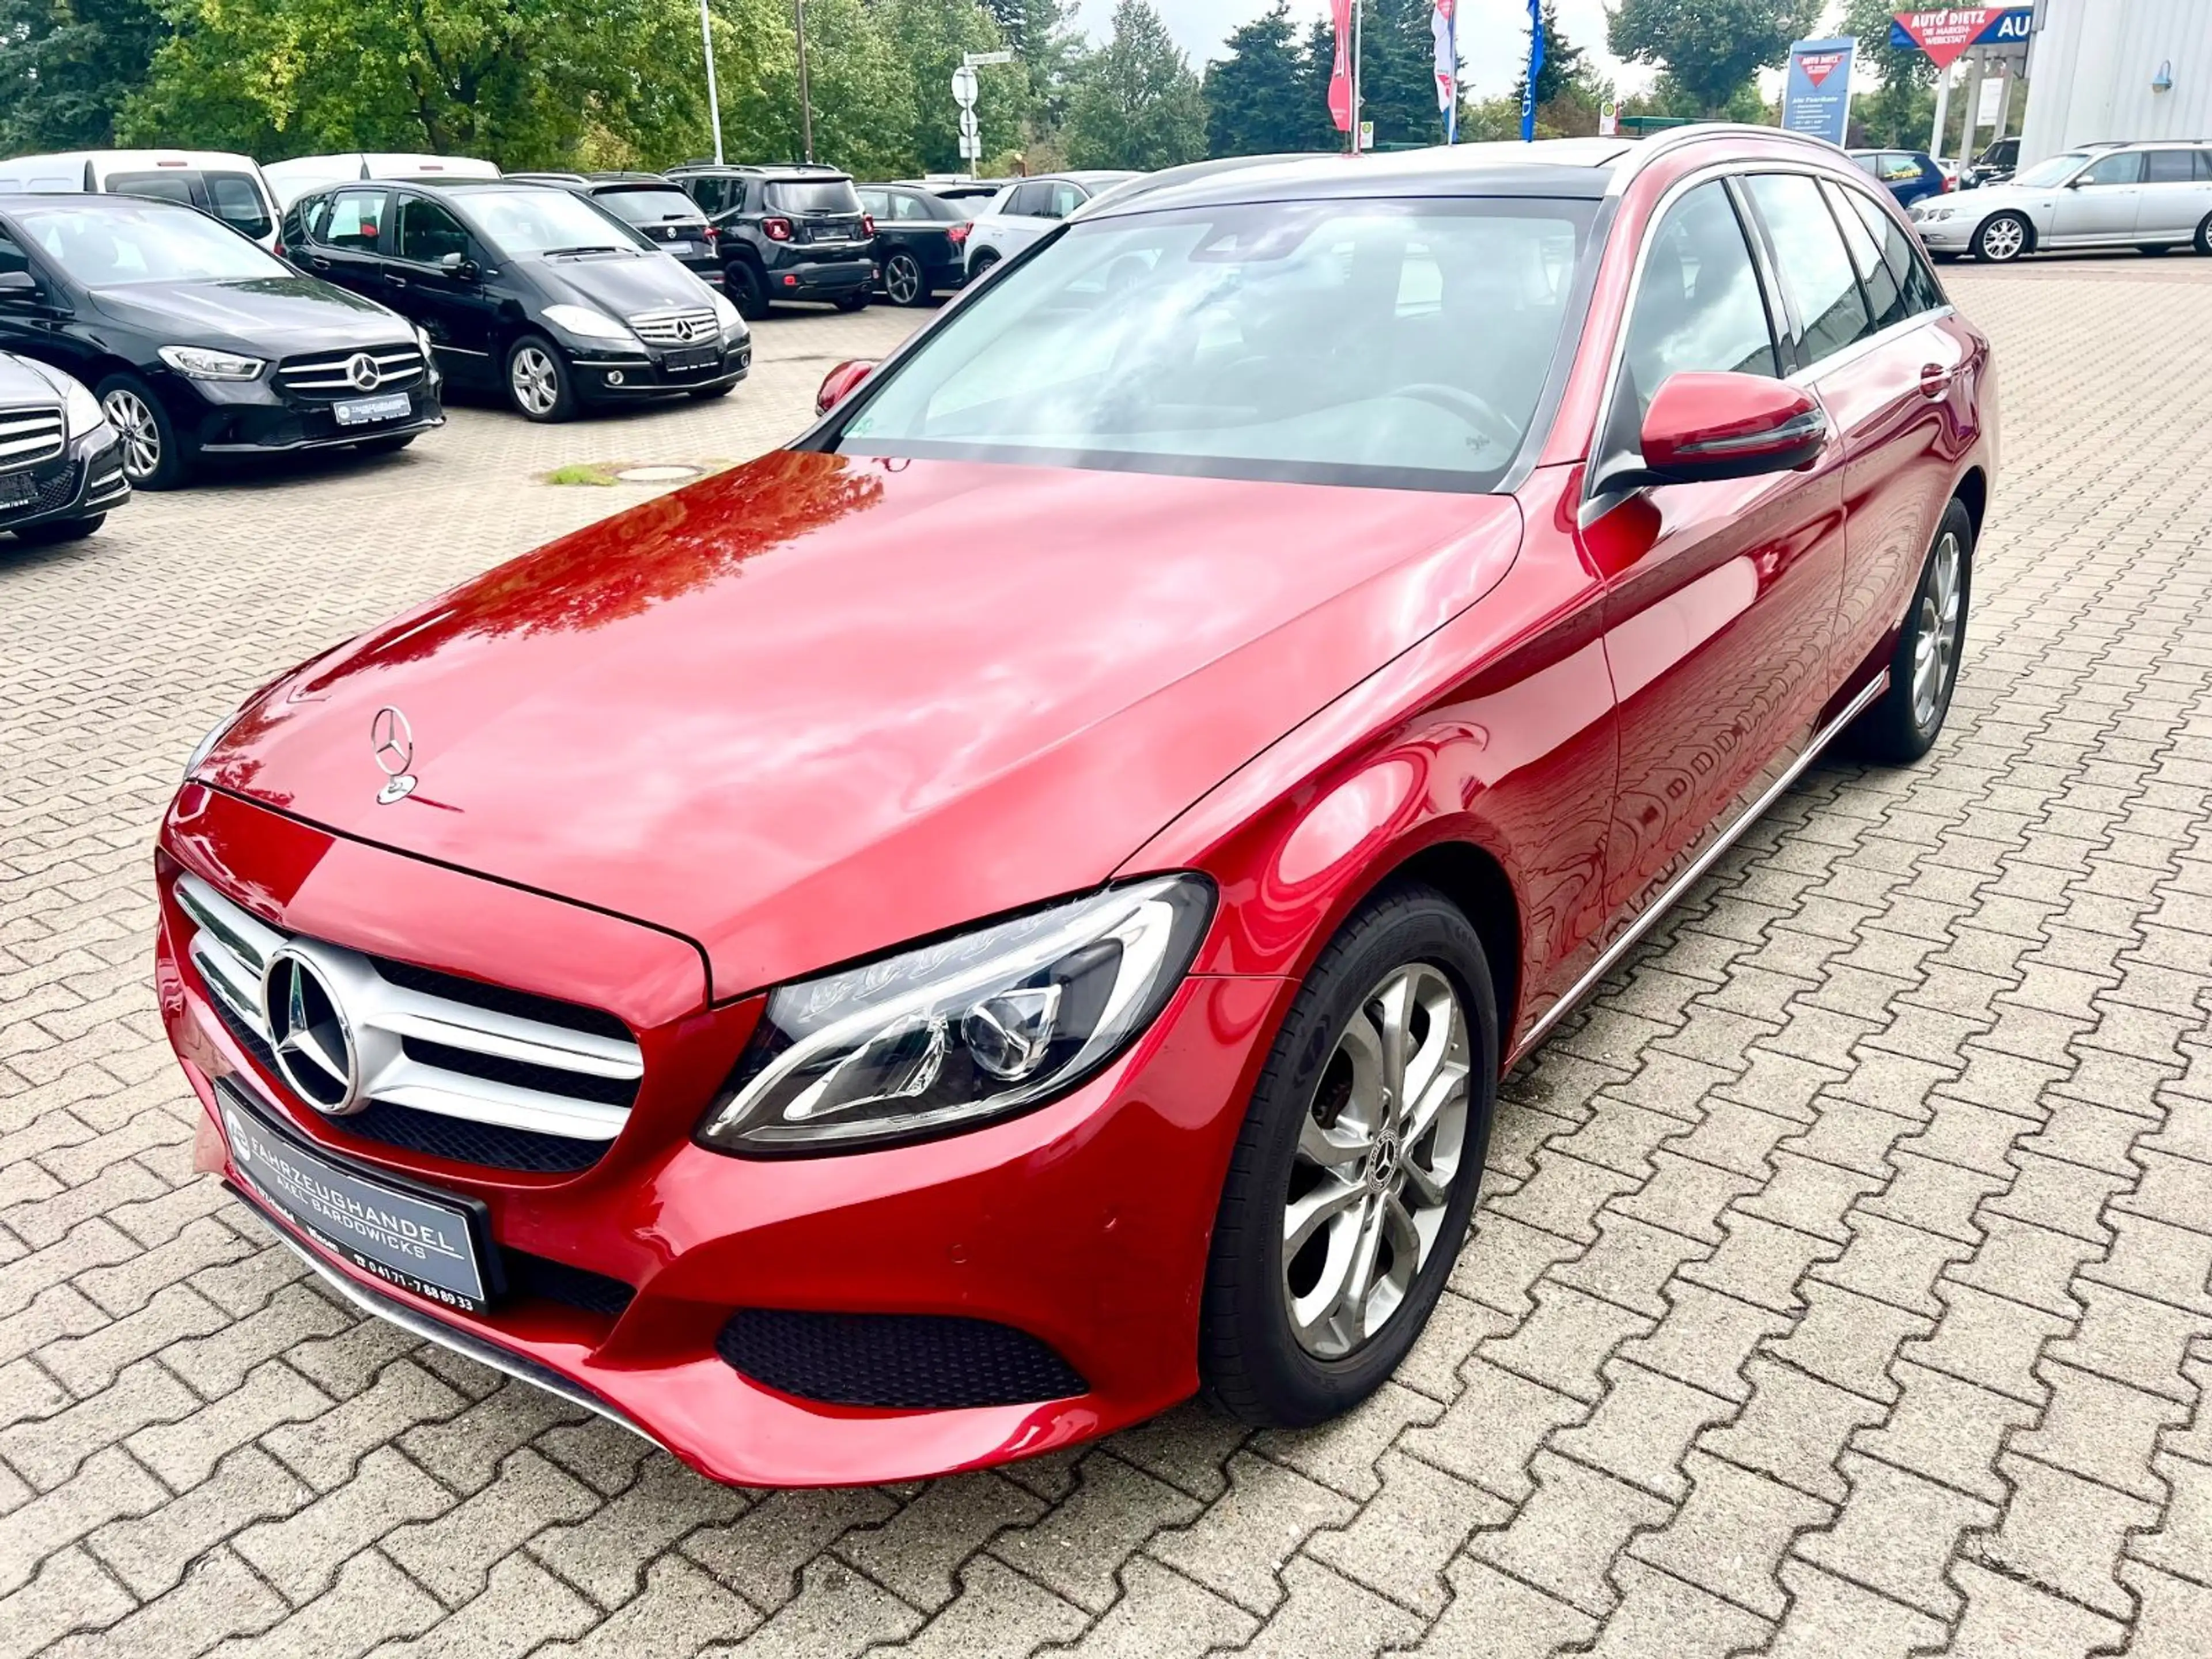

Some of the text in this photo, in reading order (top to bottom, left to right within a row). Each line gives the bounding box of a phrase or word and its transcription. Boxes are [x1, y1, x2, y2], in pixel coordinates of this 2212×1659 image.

[1911, 11, 1986, 28] AUTO DIETZ
[251, 1137, 454, 1252] FAHRZEUGHANDEL
[276, 1174, 309, 1205] AXEL
[312, 1199, 426, 1259] BARDOWICKS
